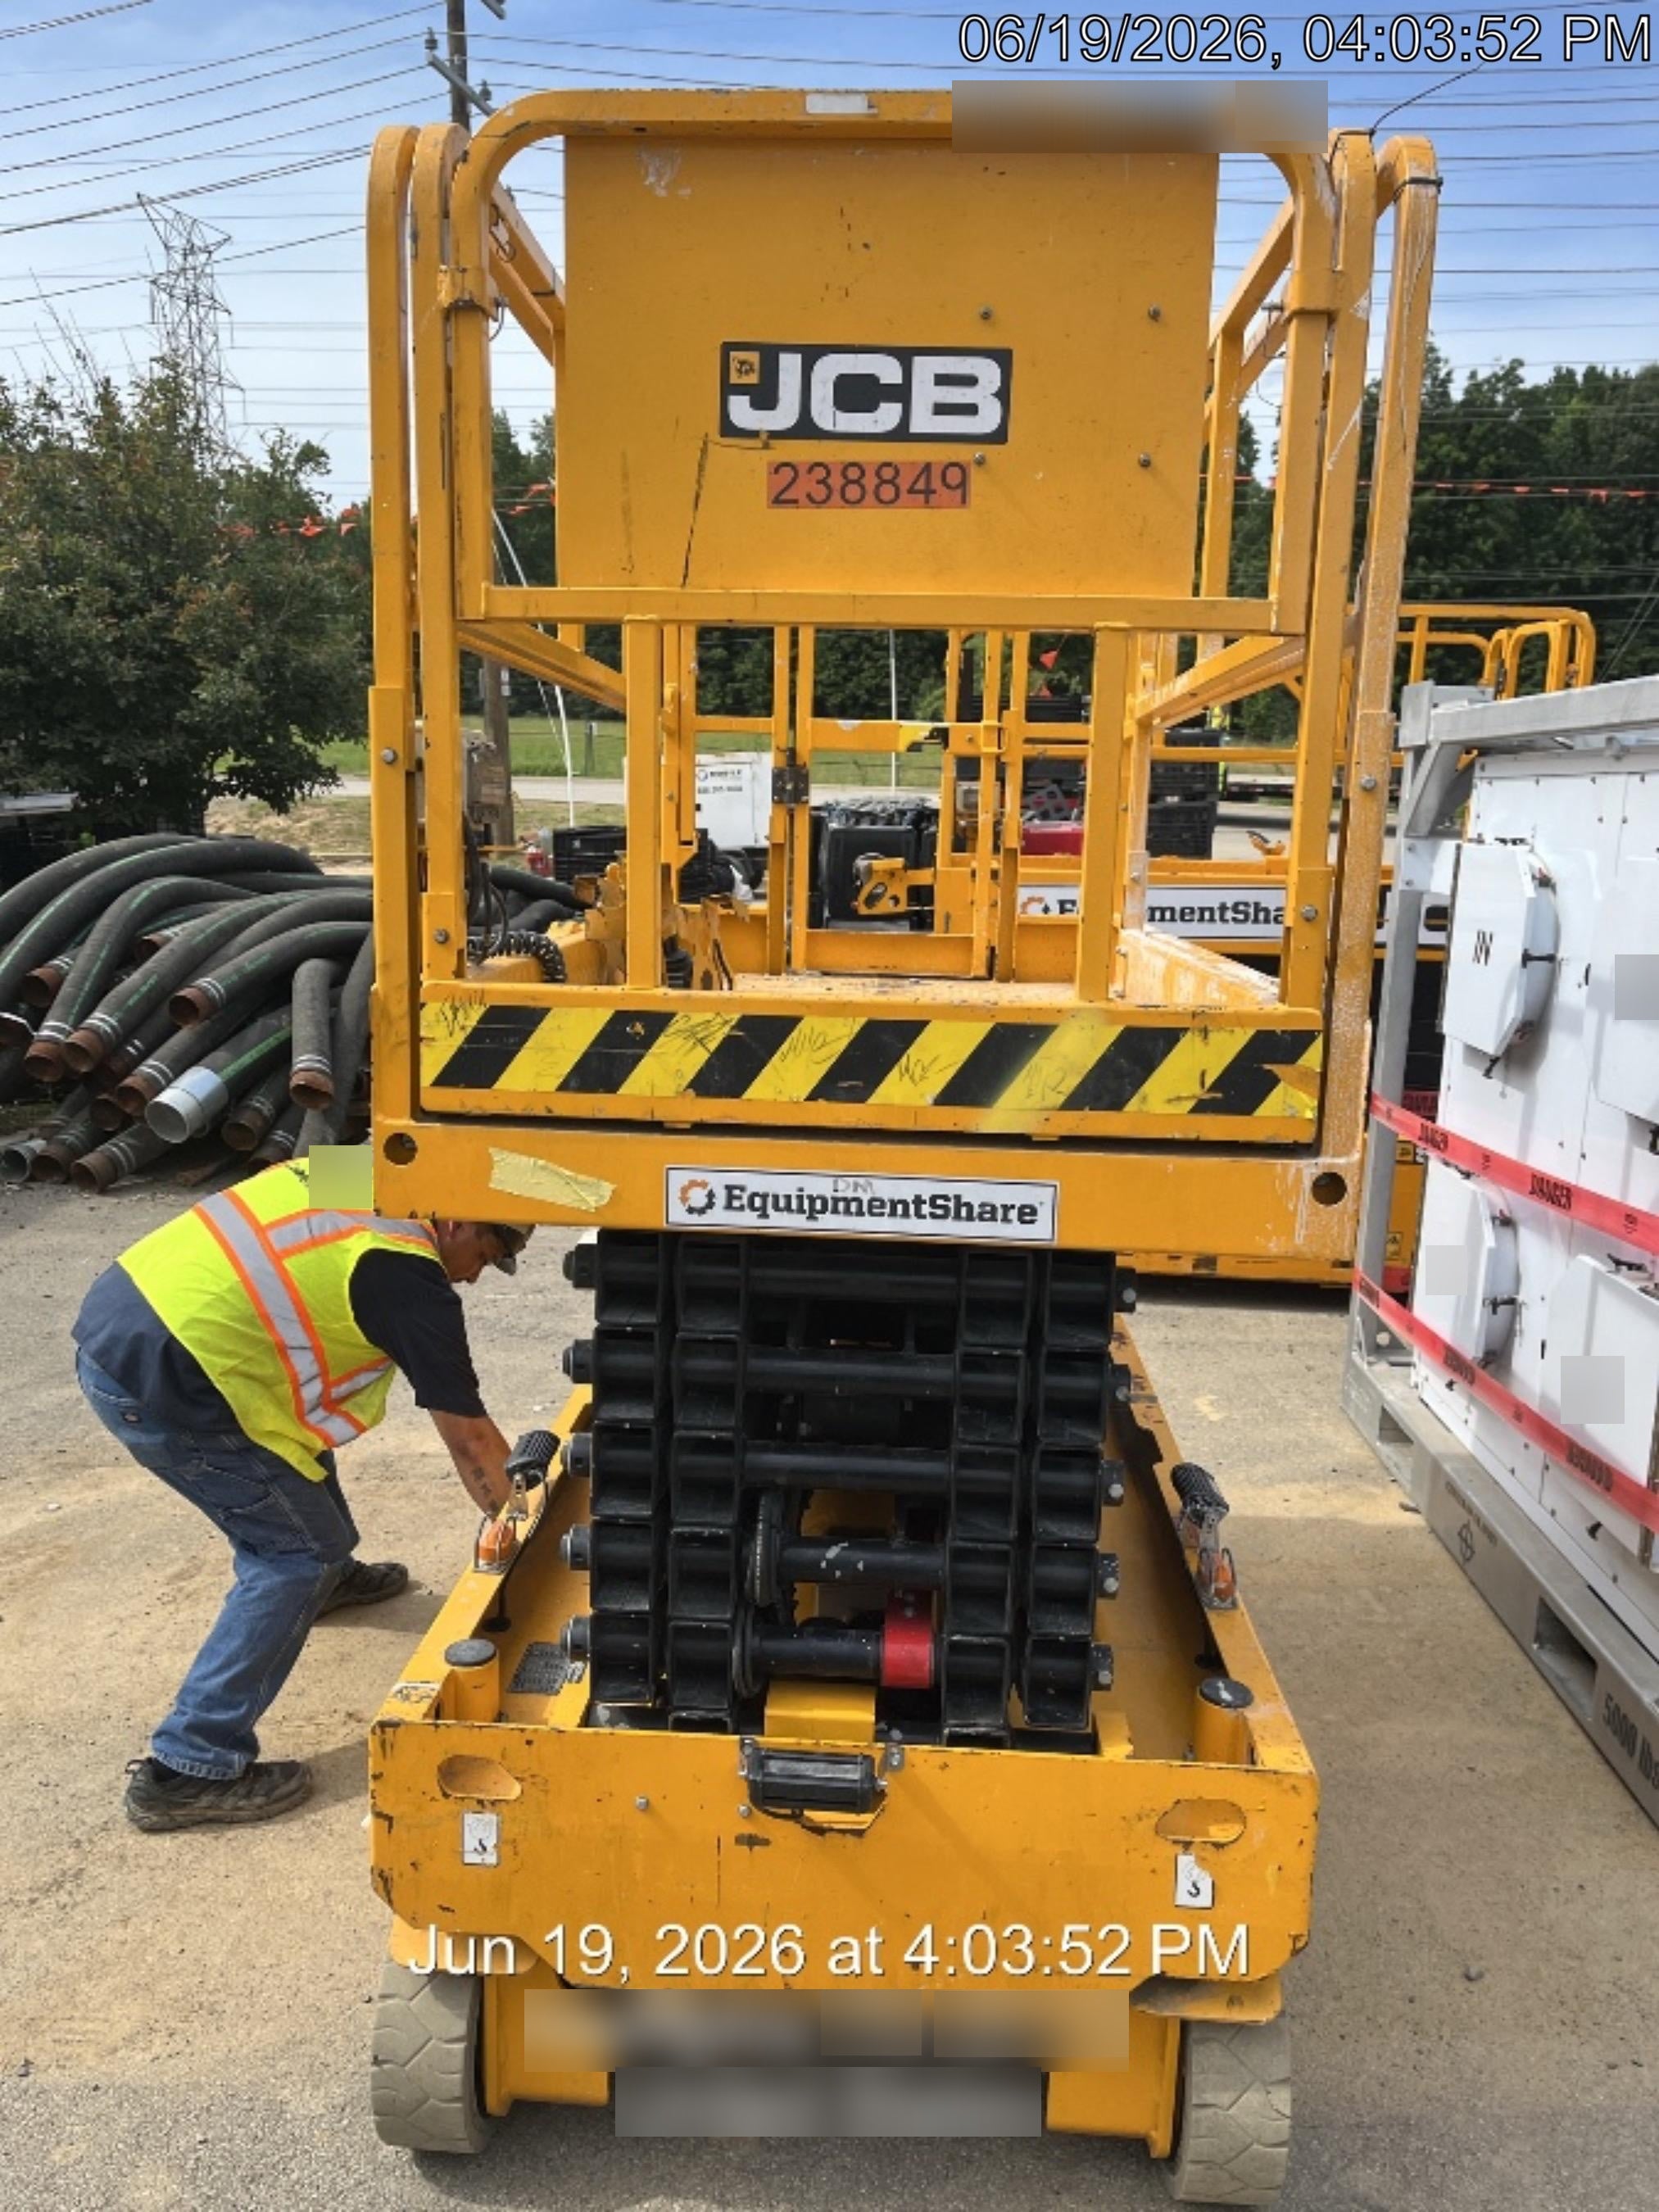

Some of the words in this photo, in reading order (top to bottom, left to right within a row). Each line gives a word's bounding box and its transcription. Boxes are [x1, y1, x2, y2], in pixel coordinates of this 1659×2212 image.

[727, 352, 1004, 433] JCB
[771, 461, 968, 505] 238849
[723, 1185, 1039, 1225] EquipmentShare
